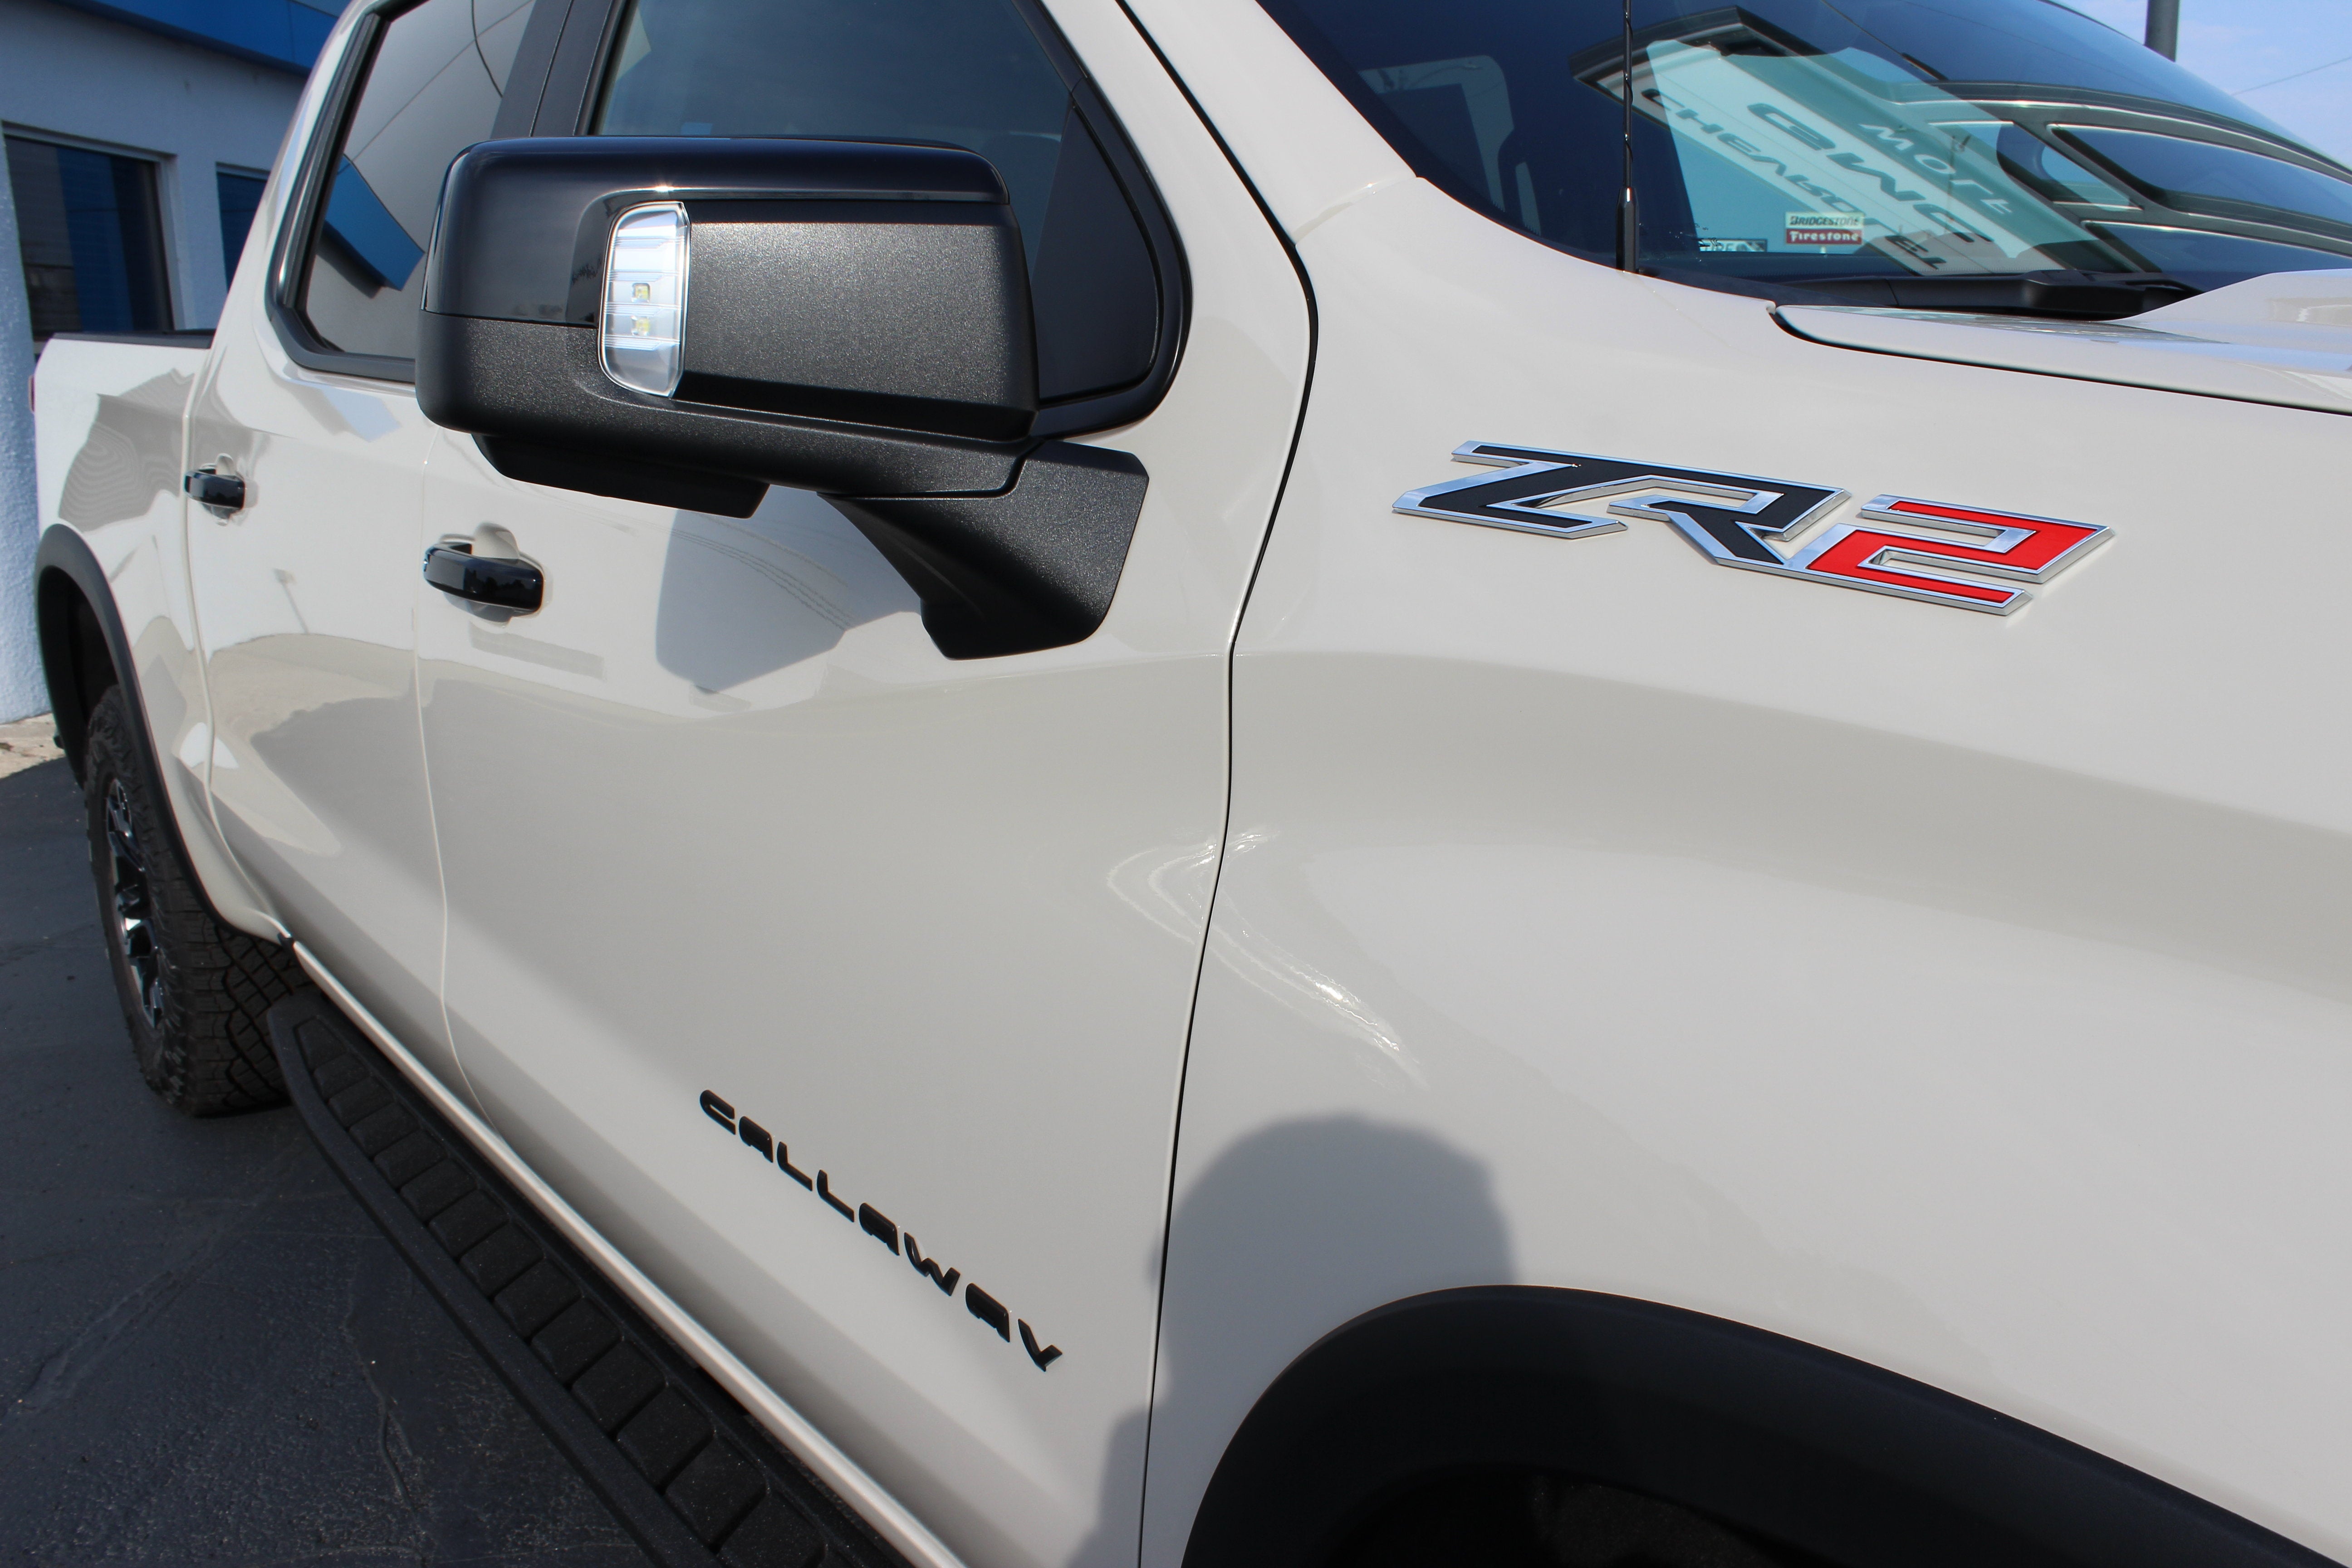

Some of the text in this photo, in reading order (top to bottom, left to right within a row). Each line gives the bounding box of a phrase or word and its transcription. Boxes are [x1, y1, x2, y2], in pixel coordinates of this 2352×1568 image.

[1789, 216, 1858, 225] BRIDGESTONE
[1789, 230, 1859, 242] Firestone
[1392, 440, 2116, 617] ZR2
[700, 1089, 1063, 1372] CALLAWAY
